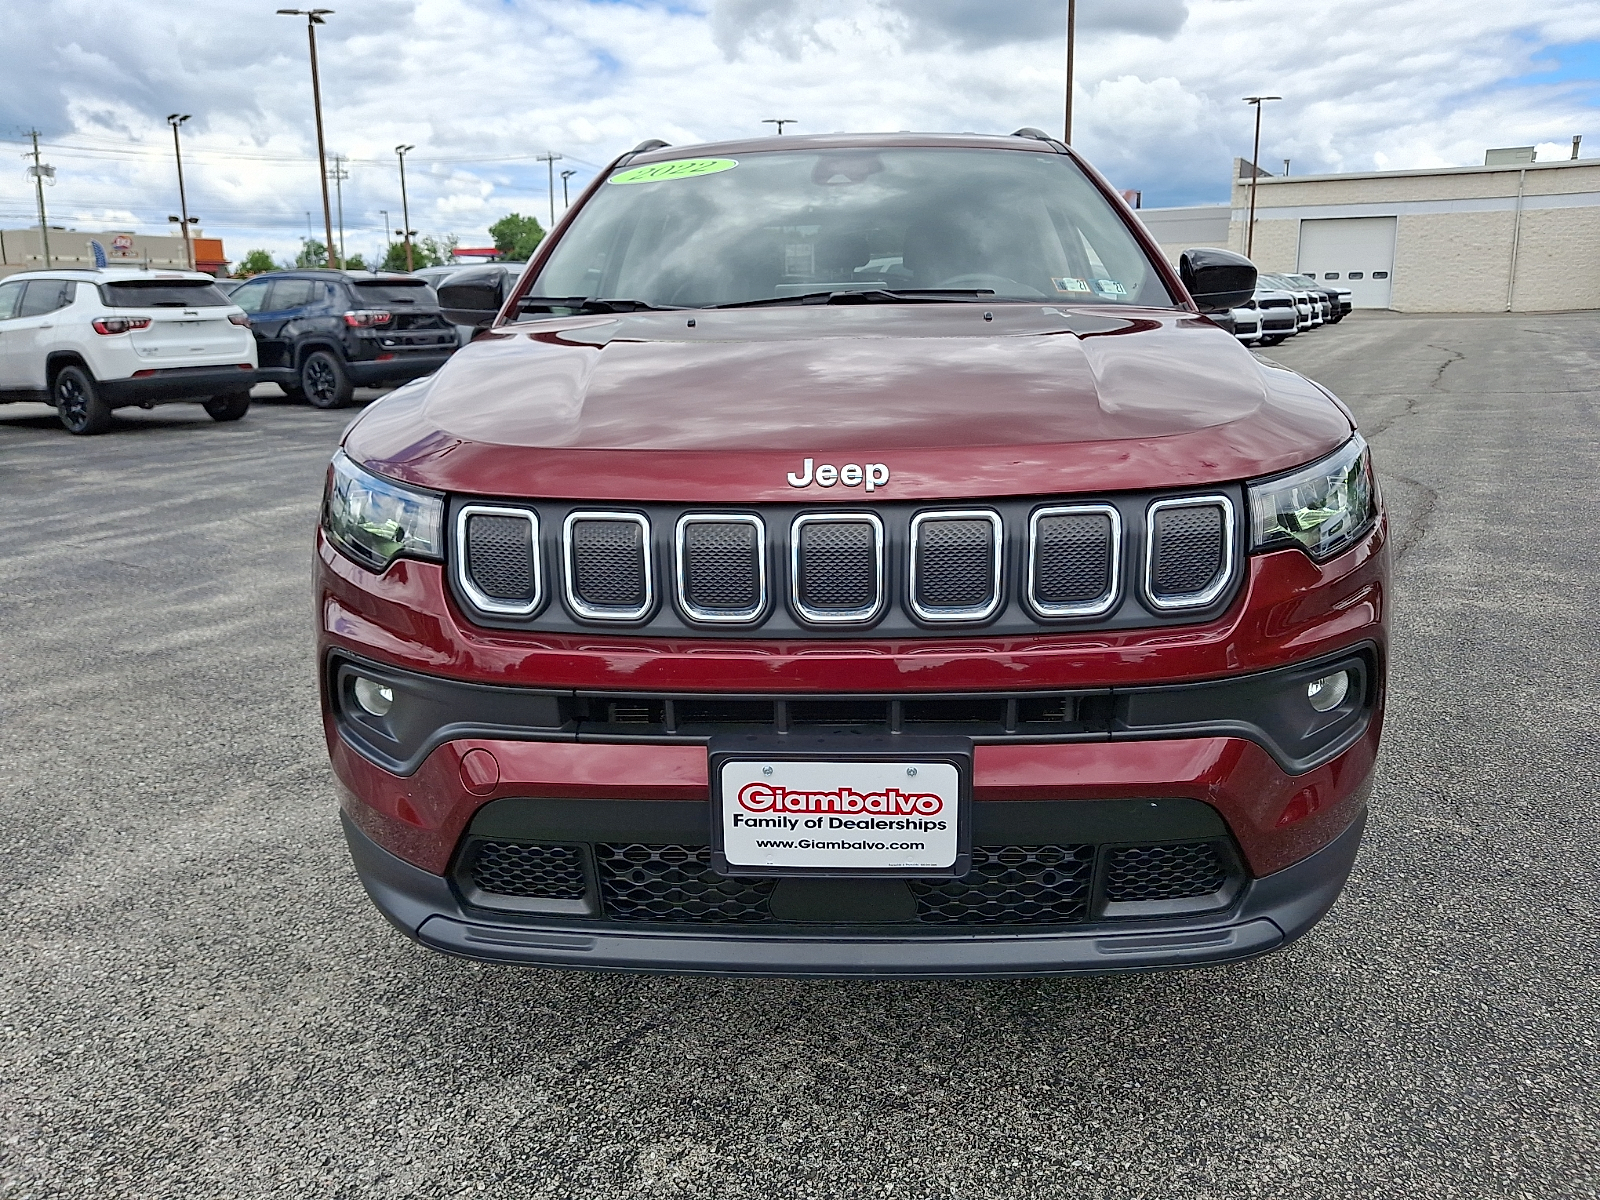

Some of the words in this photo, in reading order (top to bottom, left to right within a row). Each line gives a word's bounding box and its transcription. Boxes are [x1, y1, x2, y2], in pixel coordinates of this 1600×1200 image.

[629, 161, 718, 181] 2022
[786, 457, 891, 493] Jeep
[738, 782, 944, 816] Giambalvo
[733, 813, 799, 831] Family
[804, 816, 824, 829] of
[829, 817, 947, 833] Dealerships
[756, 839, 925, 851] www.Giambalvo.com
